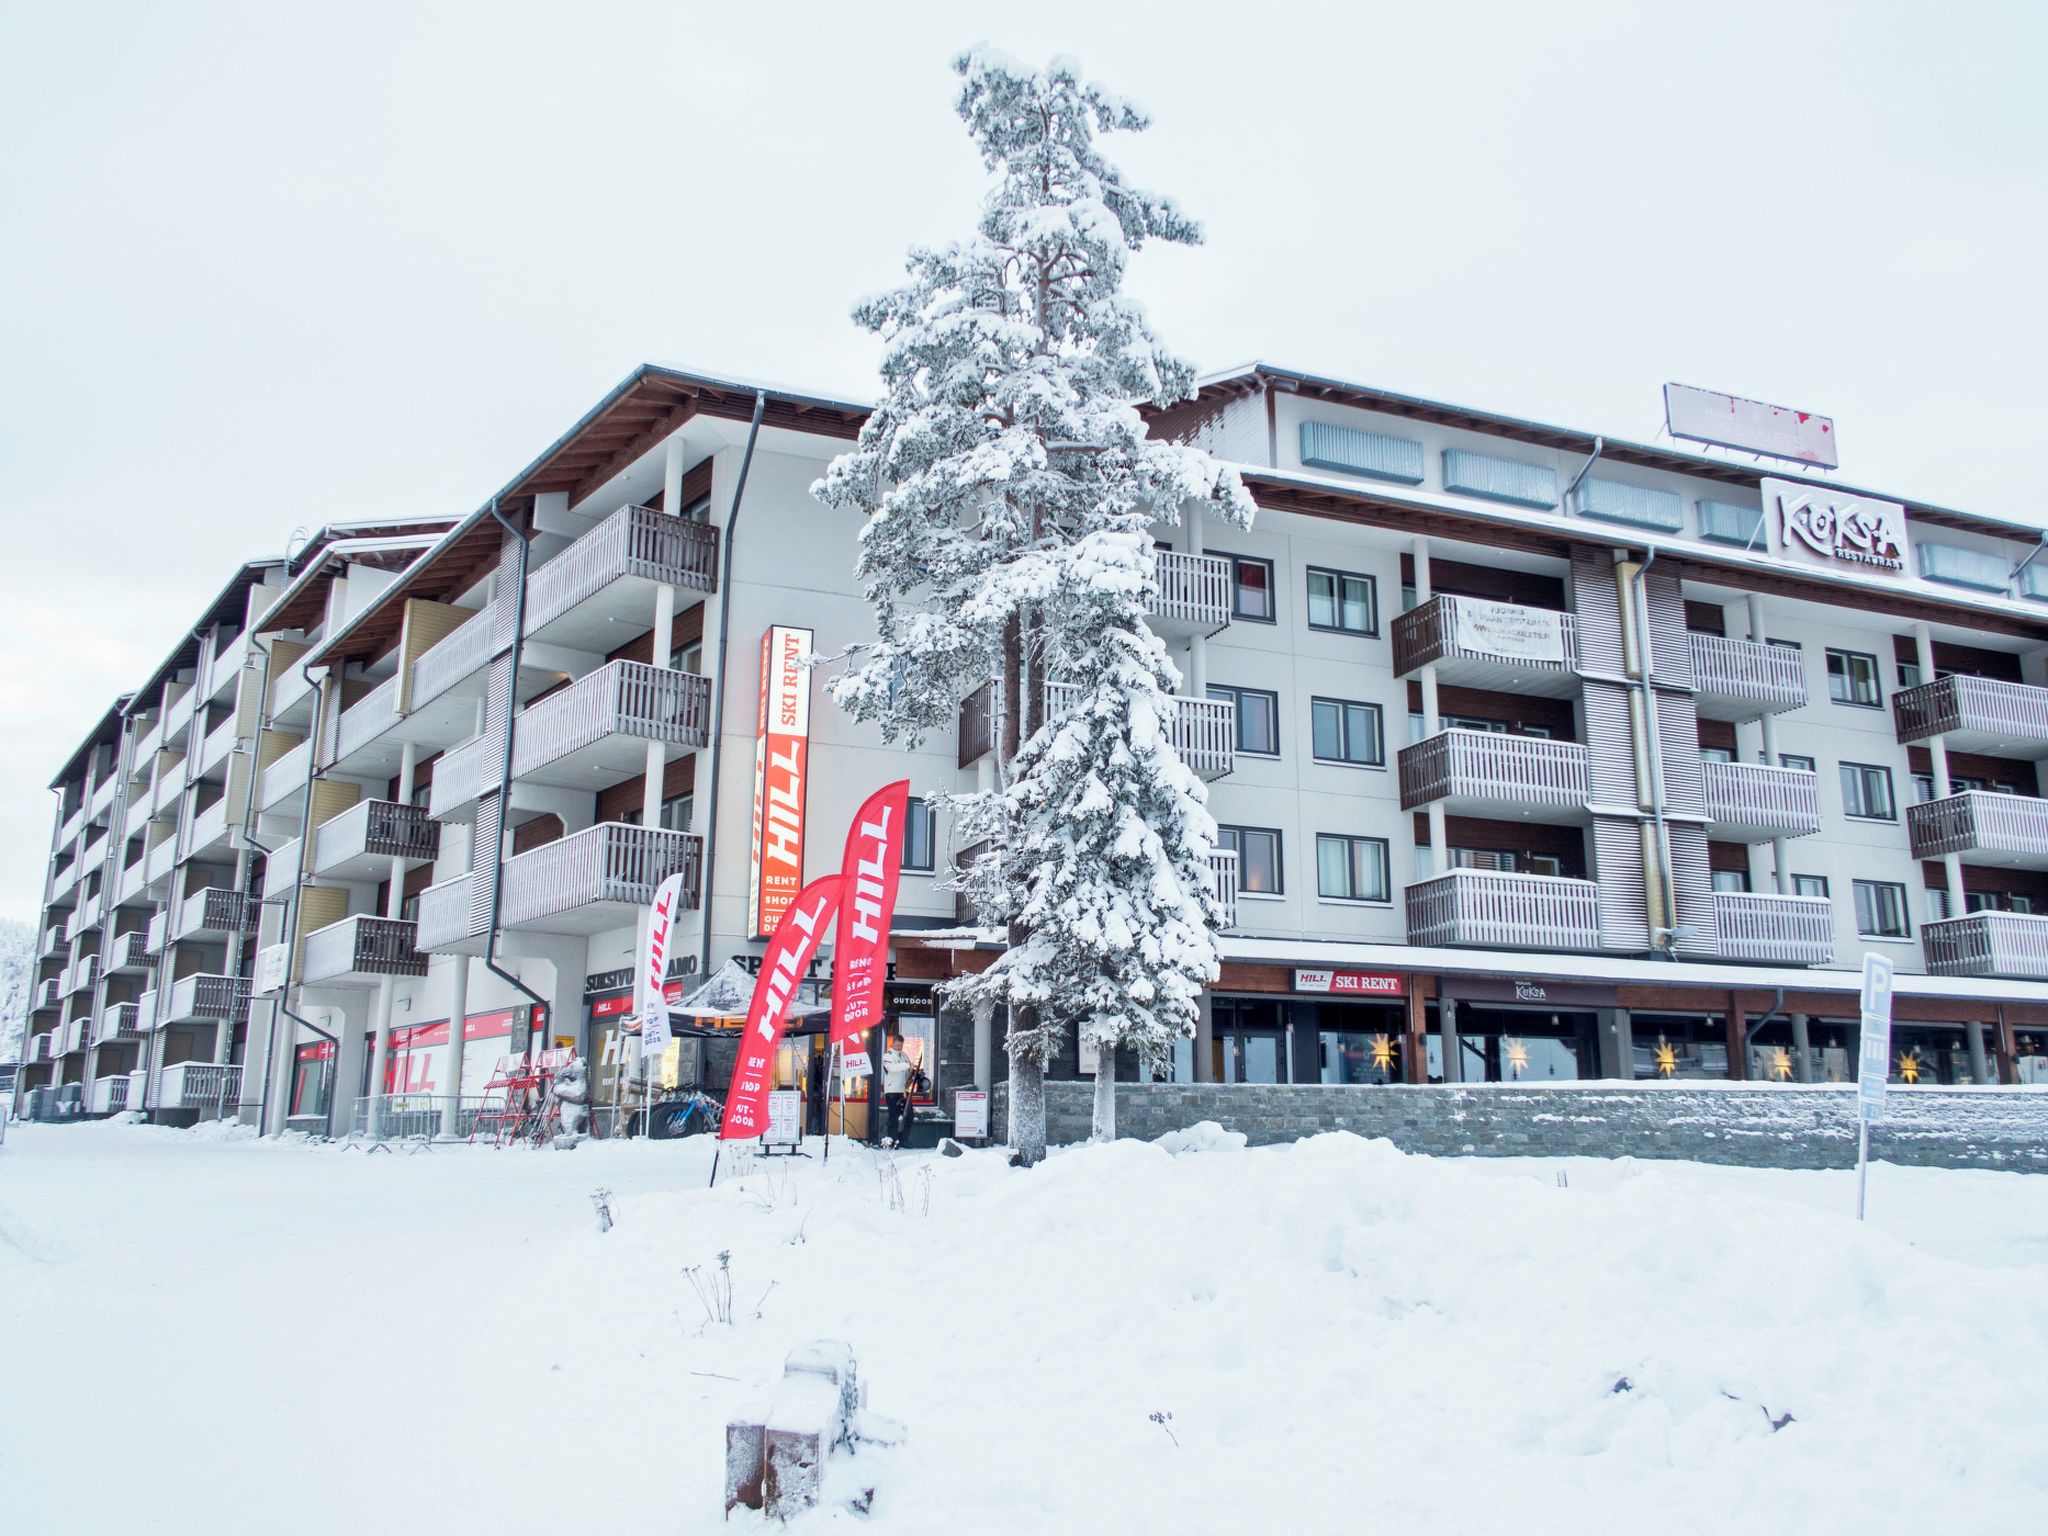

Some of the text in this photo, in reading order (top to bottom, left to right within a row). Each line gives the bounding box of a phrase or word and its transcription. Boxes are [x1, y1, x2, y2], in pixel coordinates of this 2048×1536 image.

[781, 633, 800, 727] SKI RENT
[767, 740, 800, 867] HILL
[766, 875, 797, 886] RENT
[852, 805, 892, 945] HILL
[764, 915, 783, 924] OU
[764, 924, 778, 932] DO
[651, 891, 673, 992] HILL
[586, 954, 698, 992] SUKSIVUAMO
[757, 896, 827, 1042] HILL
[1299, 973, 1327, 983] HILL
[1335, 975, 1398, 991] SKI RENT
[1869, 964, 1888, 1011] P
[893, 996, 933, 1005] OUTDOOR
[846, 1059, 867, 1069] HILL
